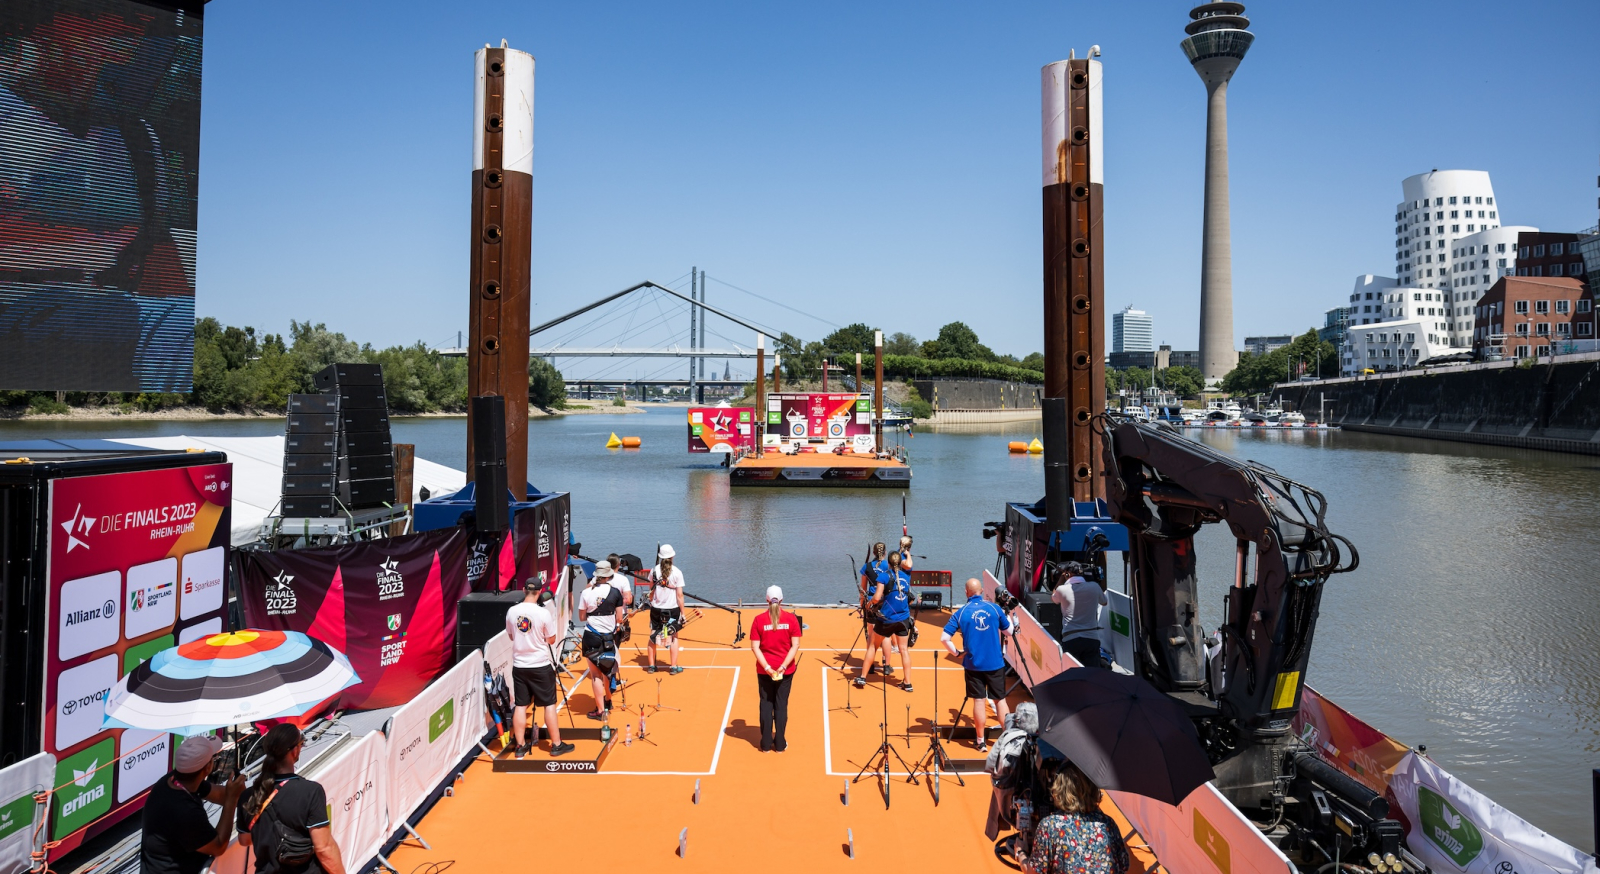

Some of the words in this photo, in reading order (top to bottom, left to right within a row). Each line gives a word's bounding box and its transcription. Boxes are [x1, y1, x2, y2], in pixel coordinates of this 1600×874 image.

[100, 513, 123, 534] DIE
[124, 508, 169, 530] FINALS
[170, 502, 197, 522] 2023
[150, 522, 195, 540] RHEIN-RUHR
[194, 578, 220, 592] Sparkasse
[377, 574, 403, 585] FINALS
[265, 590, 295, 599] FINALS
[379, 581, 404, 596] 2023
[266, 598, 297, 610] 2023
[65, 606, 101, 627] Allianz
[381, 640, 407, 653] SPORT
[380, 656, 400, 667] NRW
[78, 687, 112, 709] TOYOT
[136, 741, 165, 761] TOYOTA
[561, 762, 596, 770] TOYOTA
[62, 784, 105, 817] erima
[0, 819, 14, 831] rima
[1434, 825, 1464, 856] erima
